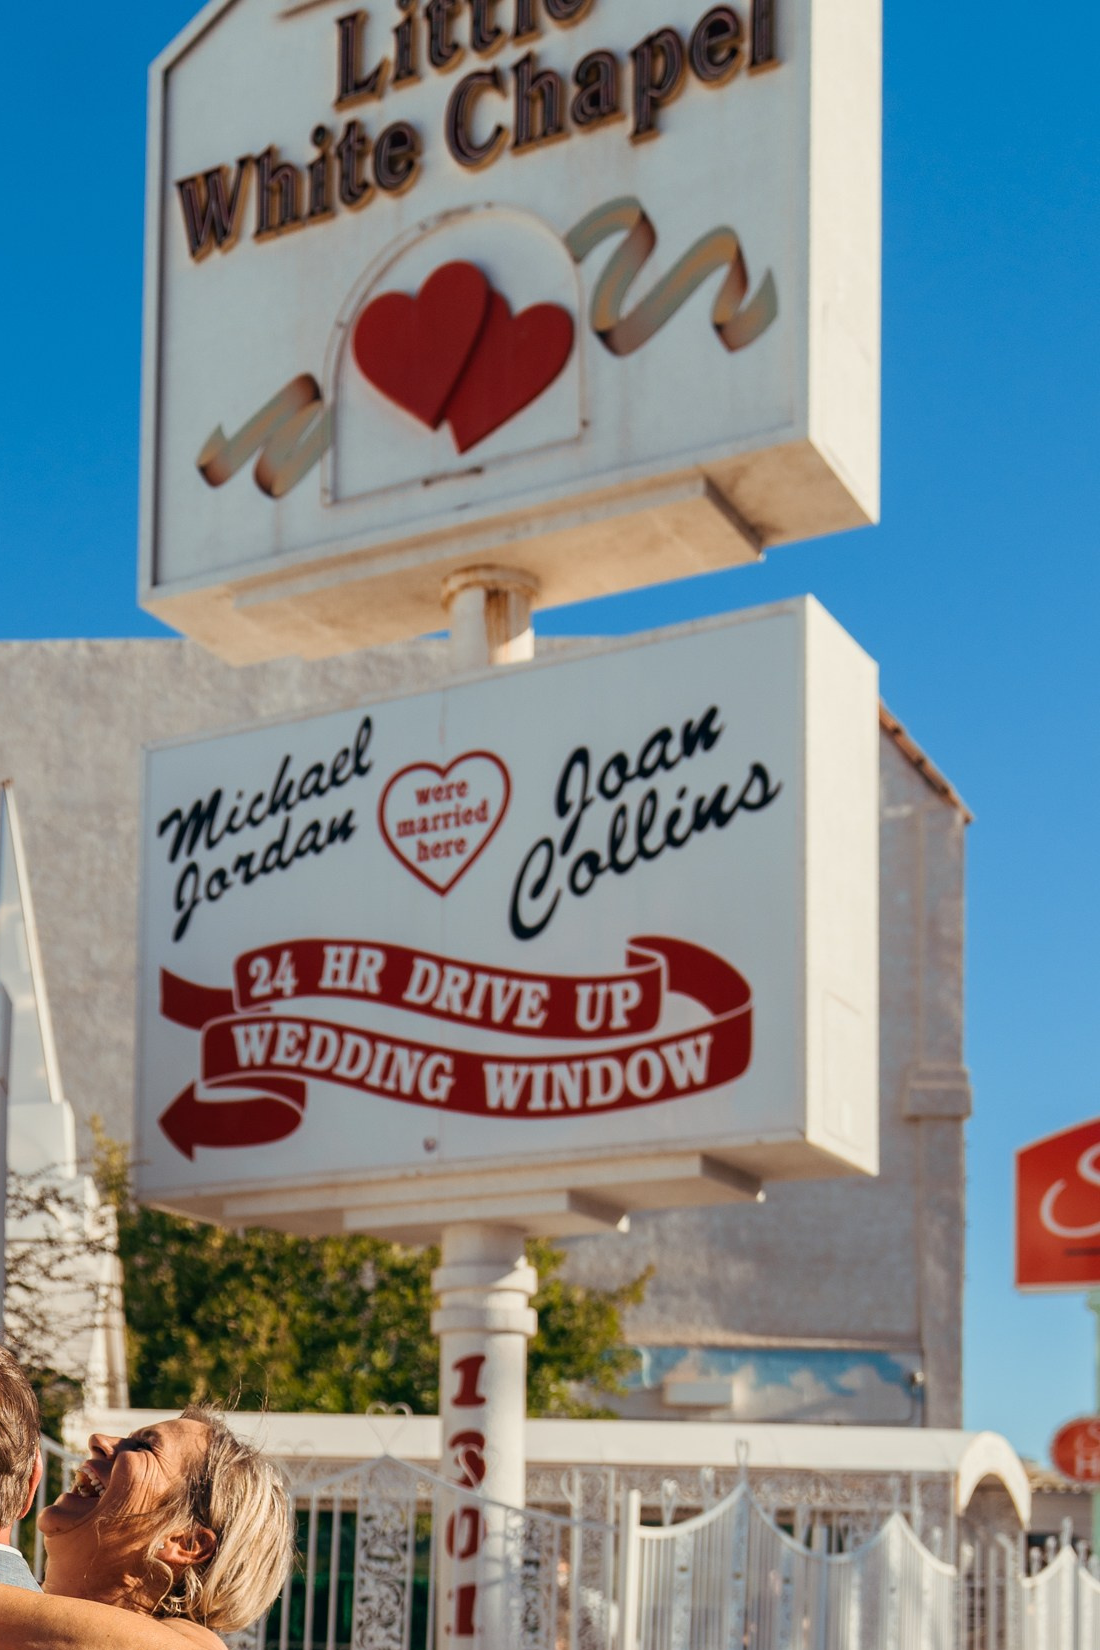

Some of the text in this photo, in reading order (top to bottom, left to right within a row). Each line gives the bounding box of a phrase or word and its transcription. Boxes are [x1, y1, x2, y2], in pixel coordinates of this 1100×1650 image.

[334, 0, 596, 112] Litt
[176, 0, 782, 264] White Chapel
[157, 715, 375, 864] Michael
[396, 798, 489, 838] married
[415, 780, 469, 806] were
[553, 705, 725, 857] Joan
[172, 807, 358, 943] Jordan
[416, 836, 467, 863] here
[509, 762, 785, 941] Collins
[248, 945, 642, 1031] 24 HR DRIVE UP
[231, 1023, 713, 1112] WEDDING WINDOW
